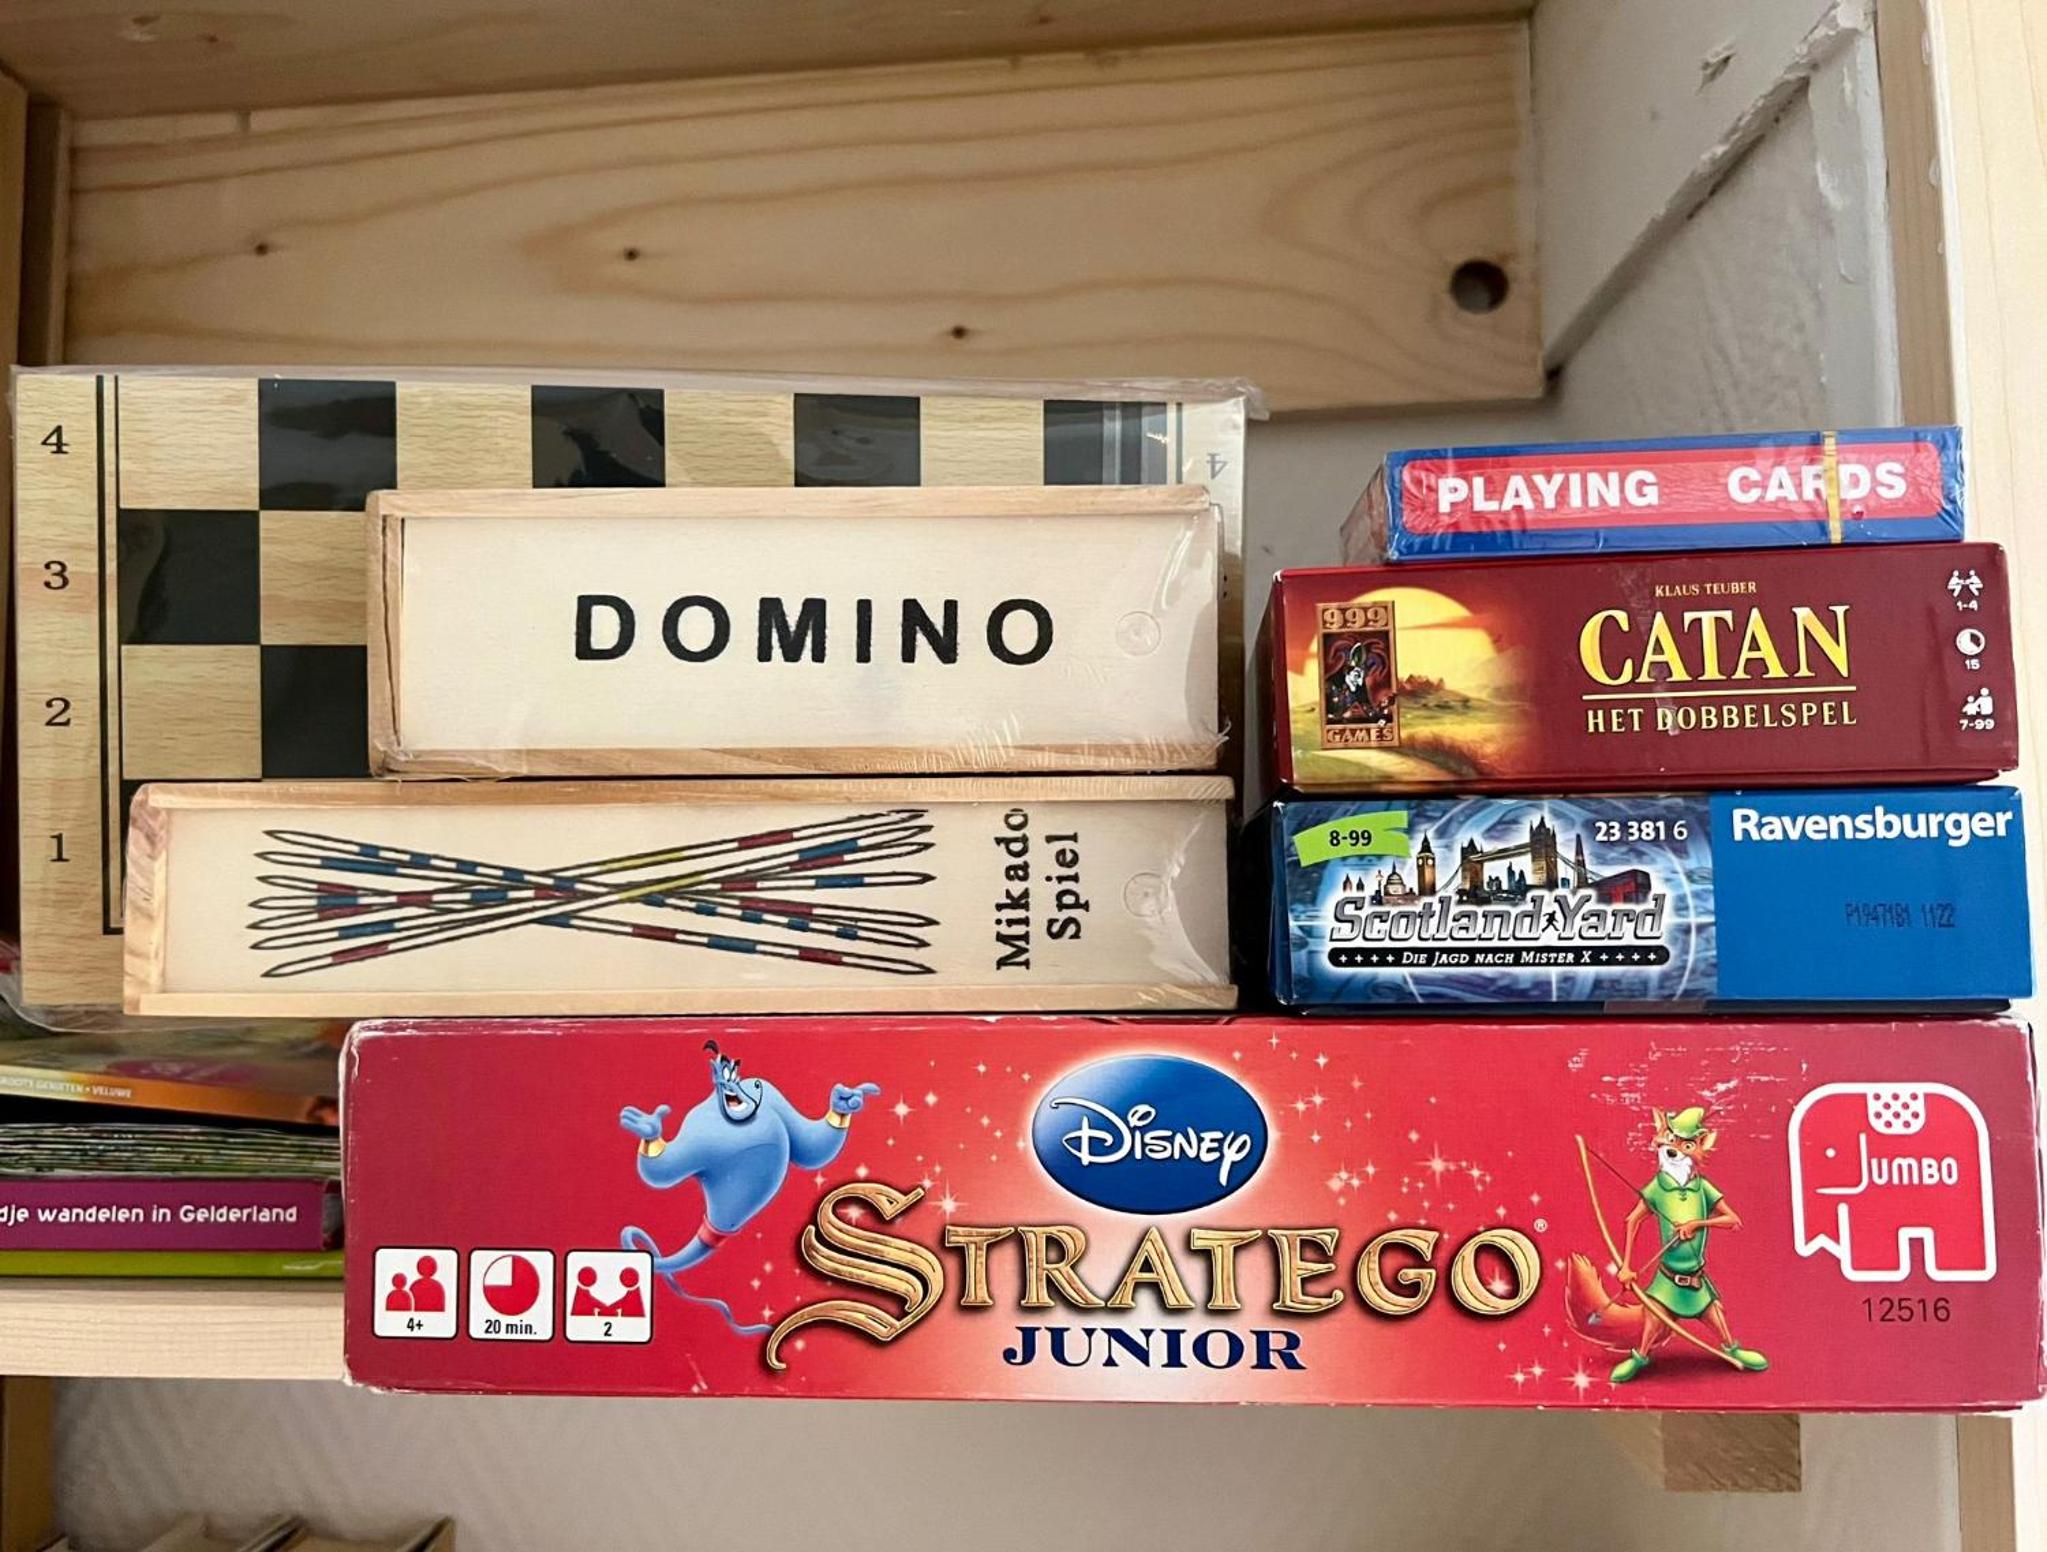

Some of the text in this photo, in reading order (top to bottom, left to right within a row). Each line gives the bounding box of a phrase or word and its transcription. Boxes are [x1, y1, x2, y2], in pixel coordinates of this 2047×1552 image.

[40, 425, 69, 455] 4
[1437, 461, 1908, 515] PLAYING CARDS
[43, 561, 69, 590] 3
[1654, 581, 1758, 598] KLAUS TEUBER
[1323, 605, 1389, 629] 999
[1956, 600, 1978, 612] 1-4
[575, 594, 1054, 666] DOMINO
[1578, 604, 1851, 686] CATAN
[1965, 659, 1981, 670] 15
[44, 698, 72, 727] 2
[1587, 701, 1858, 733] HET DOBBELSPEL
[1959, 719, 1995, 731] 7-99
[1327, 727, 1394, 743] GAMES
[1328, 828, 1373, 848] 8-99
[1595, 819, 1689, 841] 23 381 6
[1731, 805, 2014, 847] Ravensburger
[50, 834, 70, 862] 1
[994, 808, 1031, 971] Mikado
[1045, 832, 1090, 940] Spiel
[1329, 891, 1667, 942] Scotland Yard
[1401, 949, 1593, 967] DIE JAGD NACH MISTER X
[37, 1205, 144, 1223] wandelen
[152, 1204, 172, 1222] in
[179, 1204, 298, 1224] Gelderland
[766, 1182, 1542, 1374] STRATEGO
[1861, 1297, 1951, 1323] 12516
[406, 1317, 424, 1332] 4+
[484, 1319, 537, 1336] 20 min.
[604, 1321, 612, 1338] 2
[1002, 1325, 1307, 1371] JUNIOR
